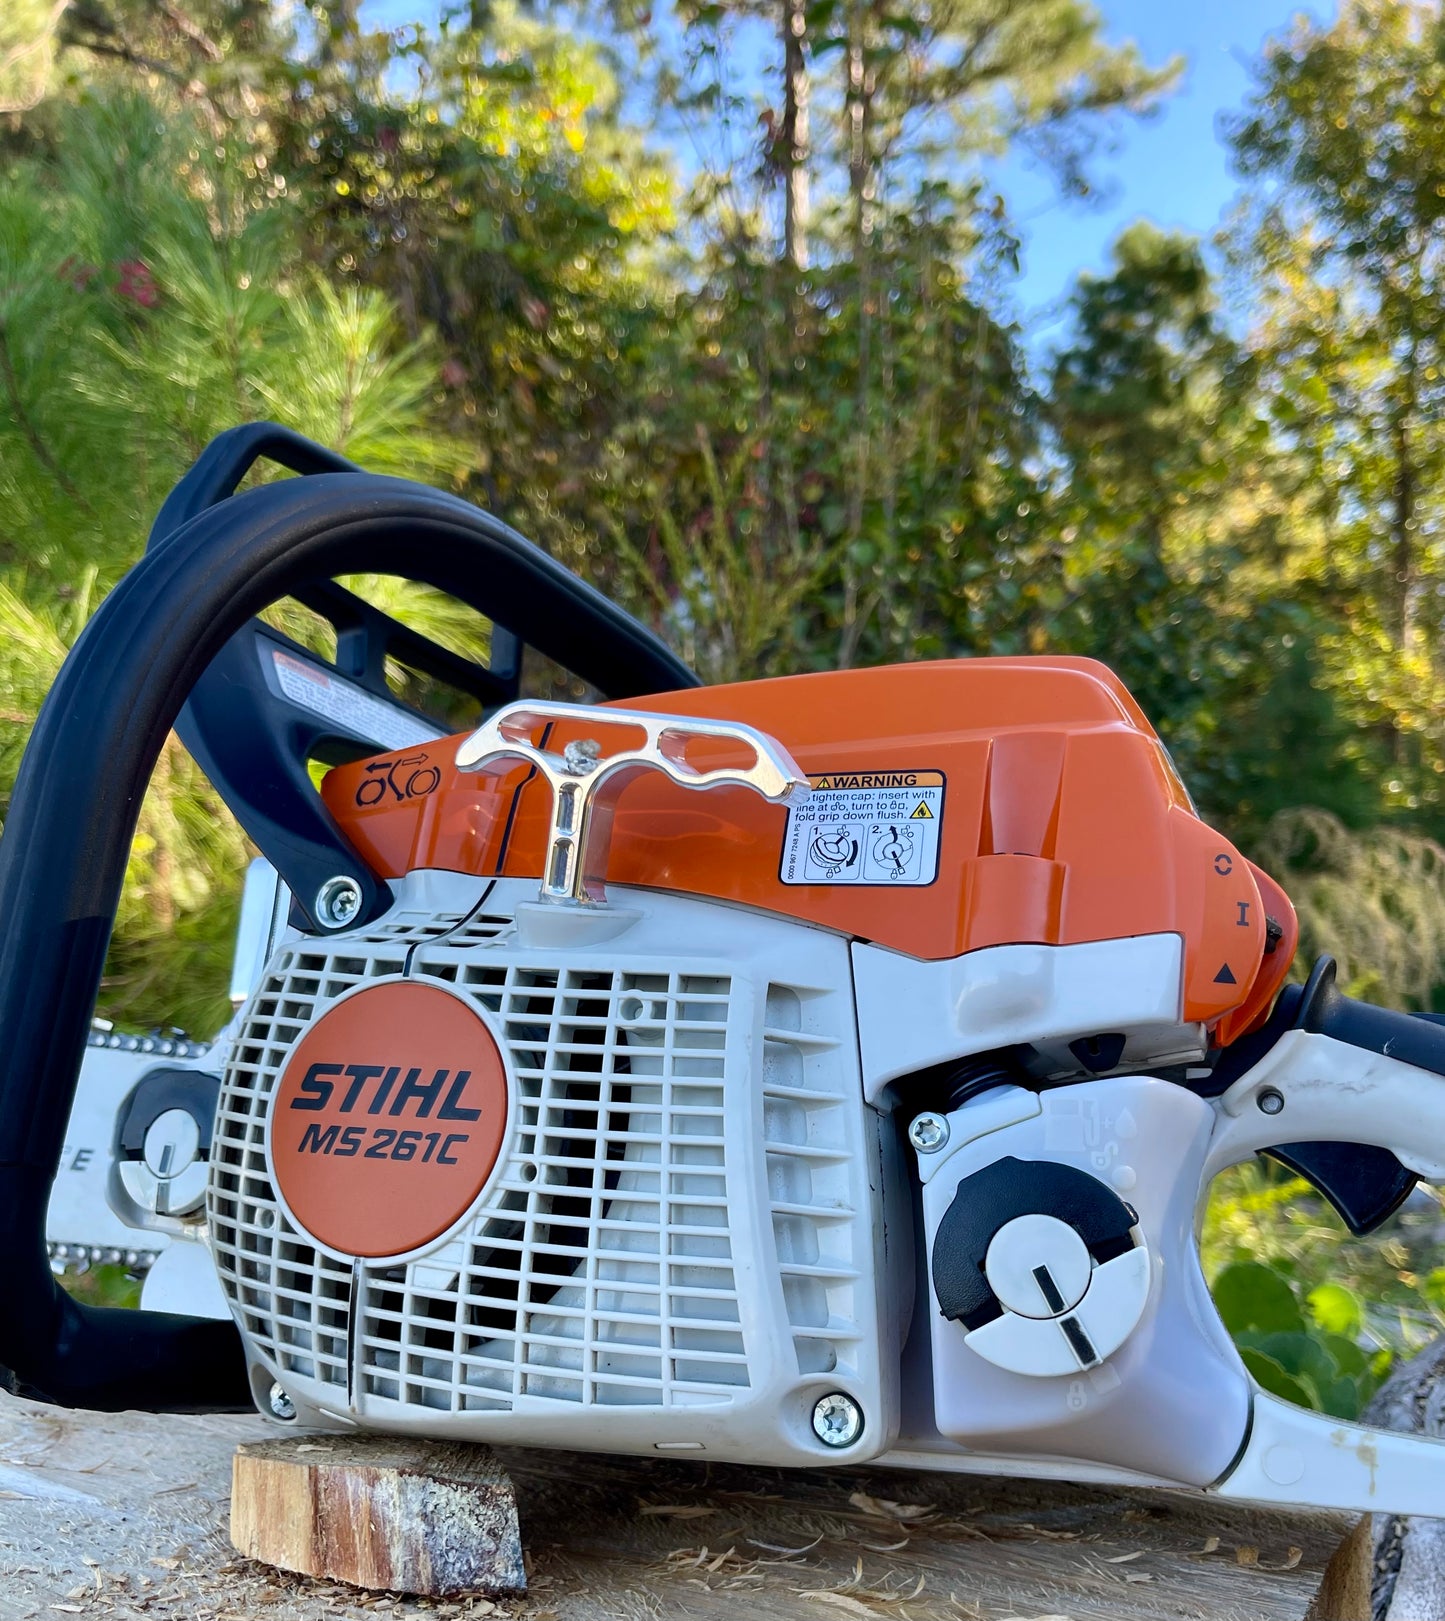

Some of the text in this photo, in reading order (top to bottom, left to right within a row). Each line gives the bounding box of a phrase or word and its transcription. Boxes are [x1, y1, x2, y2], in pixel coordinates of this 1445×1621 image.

[833, 774, 917, 788] WARNING
[812, 793, 849, 803] tighten
[850, 793, 875, 802] cap:
[878, 791, 909, 800] insert
[912, 790, 935, 799] with
[817, 803, 828, 811] at
[851, 802, 873, 811] turn
[876, 802, 887, 810] to
[795, 811, 907, 822] fold grip down flush.
[813, 826, 822, 835] 1.
[871, 825, 882, 834] 2.
[290, 1063, 482, 1121] STIHL
[298, 1123, 470, 1165] MS 261C
